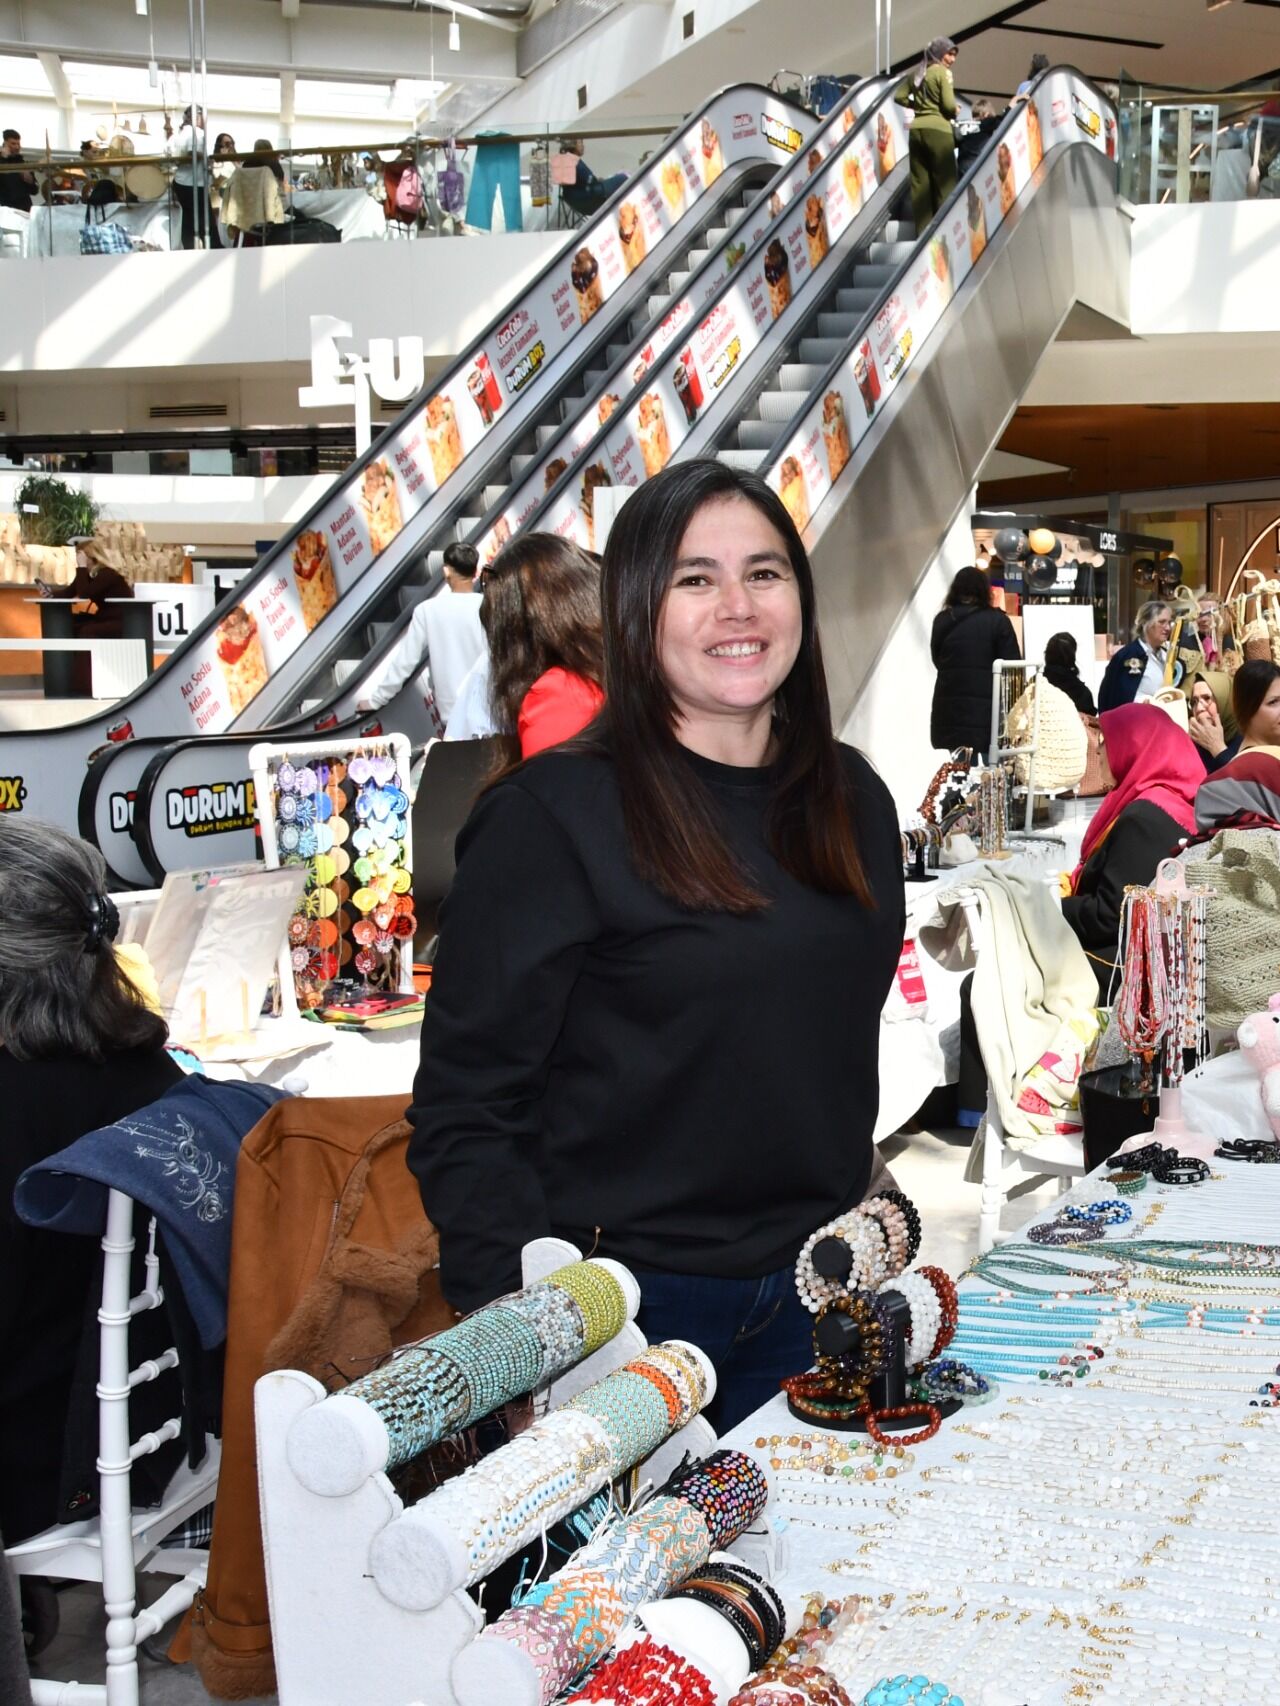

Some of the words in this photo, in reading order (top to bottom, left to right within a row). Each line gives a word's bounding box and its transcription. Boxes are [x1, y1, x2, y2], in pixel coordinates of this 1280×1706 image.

[158, 603, 188, 636] u1
[191, 662, 212, 686] Soslu
[189, 687, 212, 714] Adana
[196, 700, 220, 729] Dürüm
